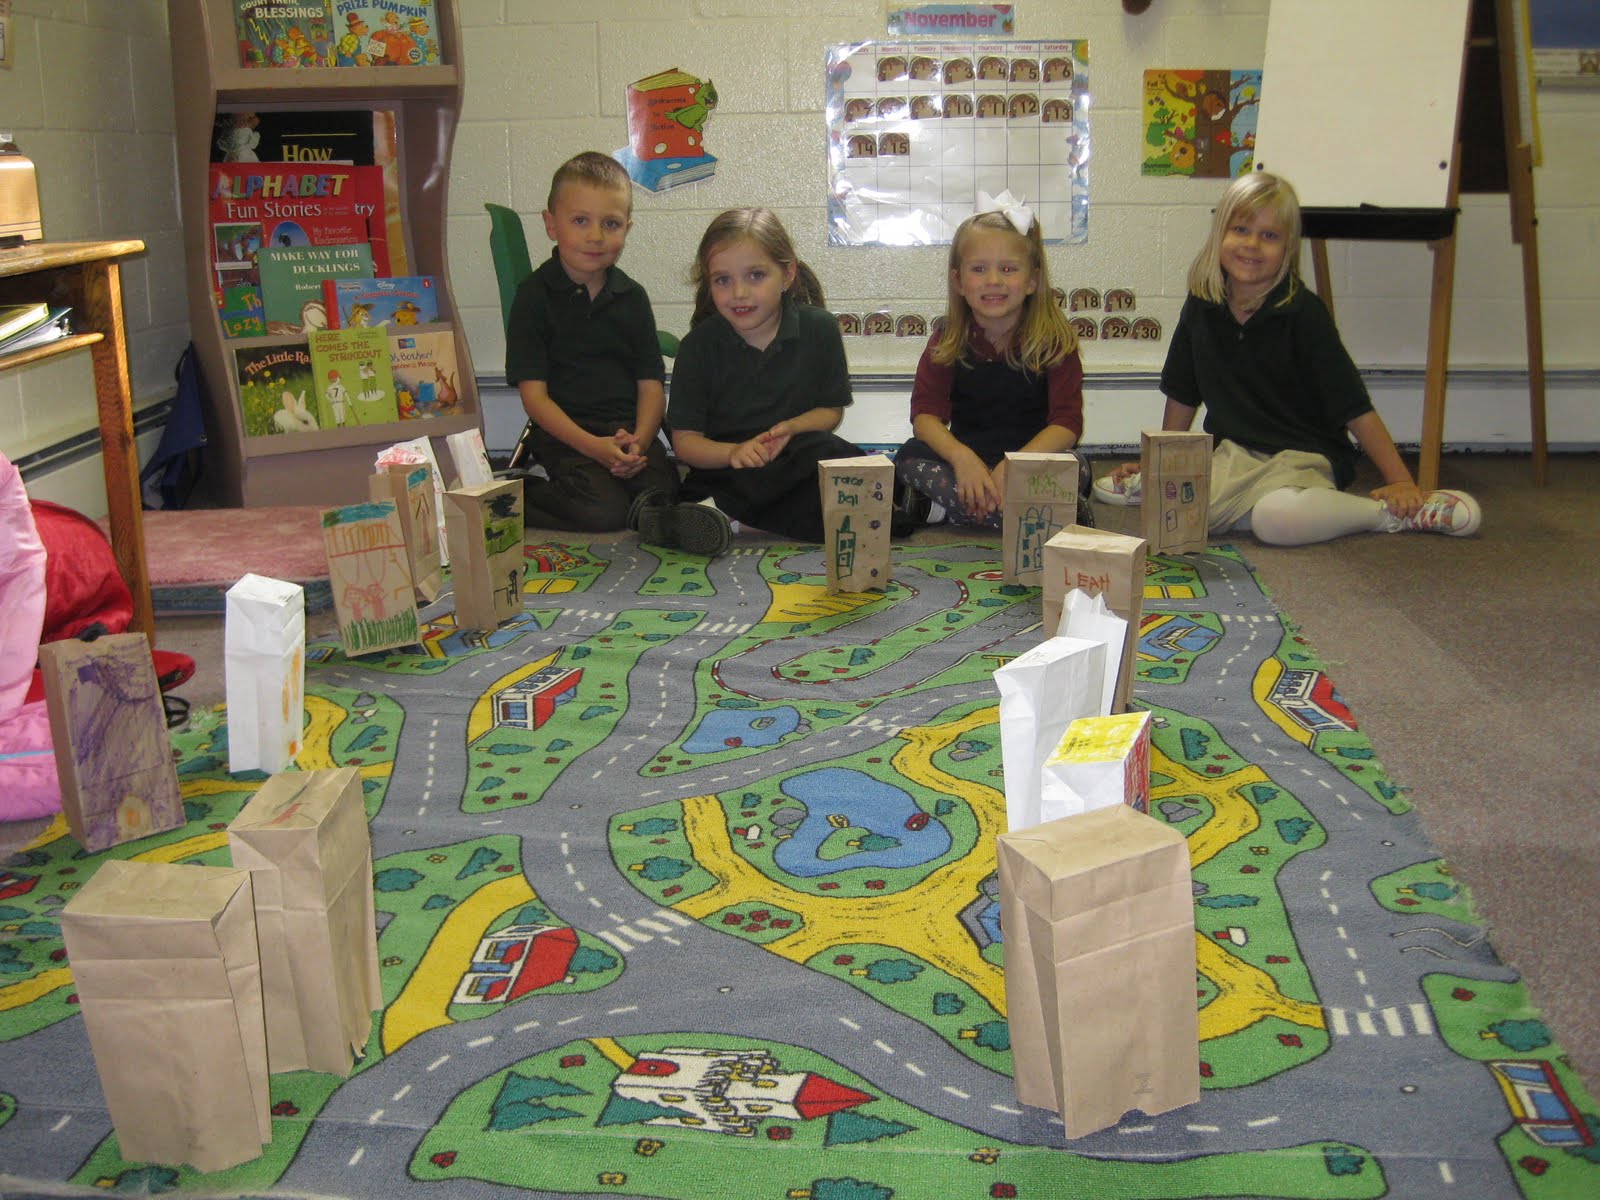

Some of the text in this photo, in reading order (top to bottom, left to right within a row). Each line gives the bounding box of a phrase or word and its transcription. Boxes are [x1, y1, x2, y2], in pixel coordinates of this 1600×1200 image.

[255, 7, 324, 19] BLESSINGS
[336, 0, 427, 17] PRIZE PUMPKIN
[903, 12, 997, 28] November
[964, 67, 974, 79] 3
[998, 67, 1007, 79] 4
[1029, 67, 1037, 80] 5
[1062, 65, 1071, 78] 6
[956, 103, 972, 115] 10
[993, 103, 1006, 116] 11
[1022, 101, 1037, 114] 12
[1055, 107, 1071, 120] 13
[282, 144, 333, 162] How
[858, 142, 874, 155] 14
[893, 142, 908, 155] 15
[211, 174, 350, 199] ALPHABET
[227, 202, 258, 219] Fun
[264, 201, 322, 218] Stories
[270, 249, 359, 262] MAKE WAY FOR
[293, 262, 361, 275] DUCKLINGS
[376, 280, 396, 290] Disney
[1057, 296, 1065, 308] 7
[1084, 296, 1099, 308] 18
[1117, 296, 1133, 309] 19
[223, 316, 262, 337] Lazy
[844, 321, 859, 334] 21
[875, 321, 892, 333] 22
[907, 323, 924, 336] 23
[1077, 325, 1094, 338] 28
[1112, 325, 1129, 338] 29
[1141, 326, 1159, 340] 30
[315, 332, 340, 344] HERE
[316, 340, 370, 353] COMES THE
[329, 349, 383, 363] STRIKEOUT
[244, 358, 268, 376] The
[265, 350, 295, 366] Little
[332, 387, 340, 398] 7
[1064, 566, 1110, 592] LEAH
